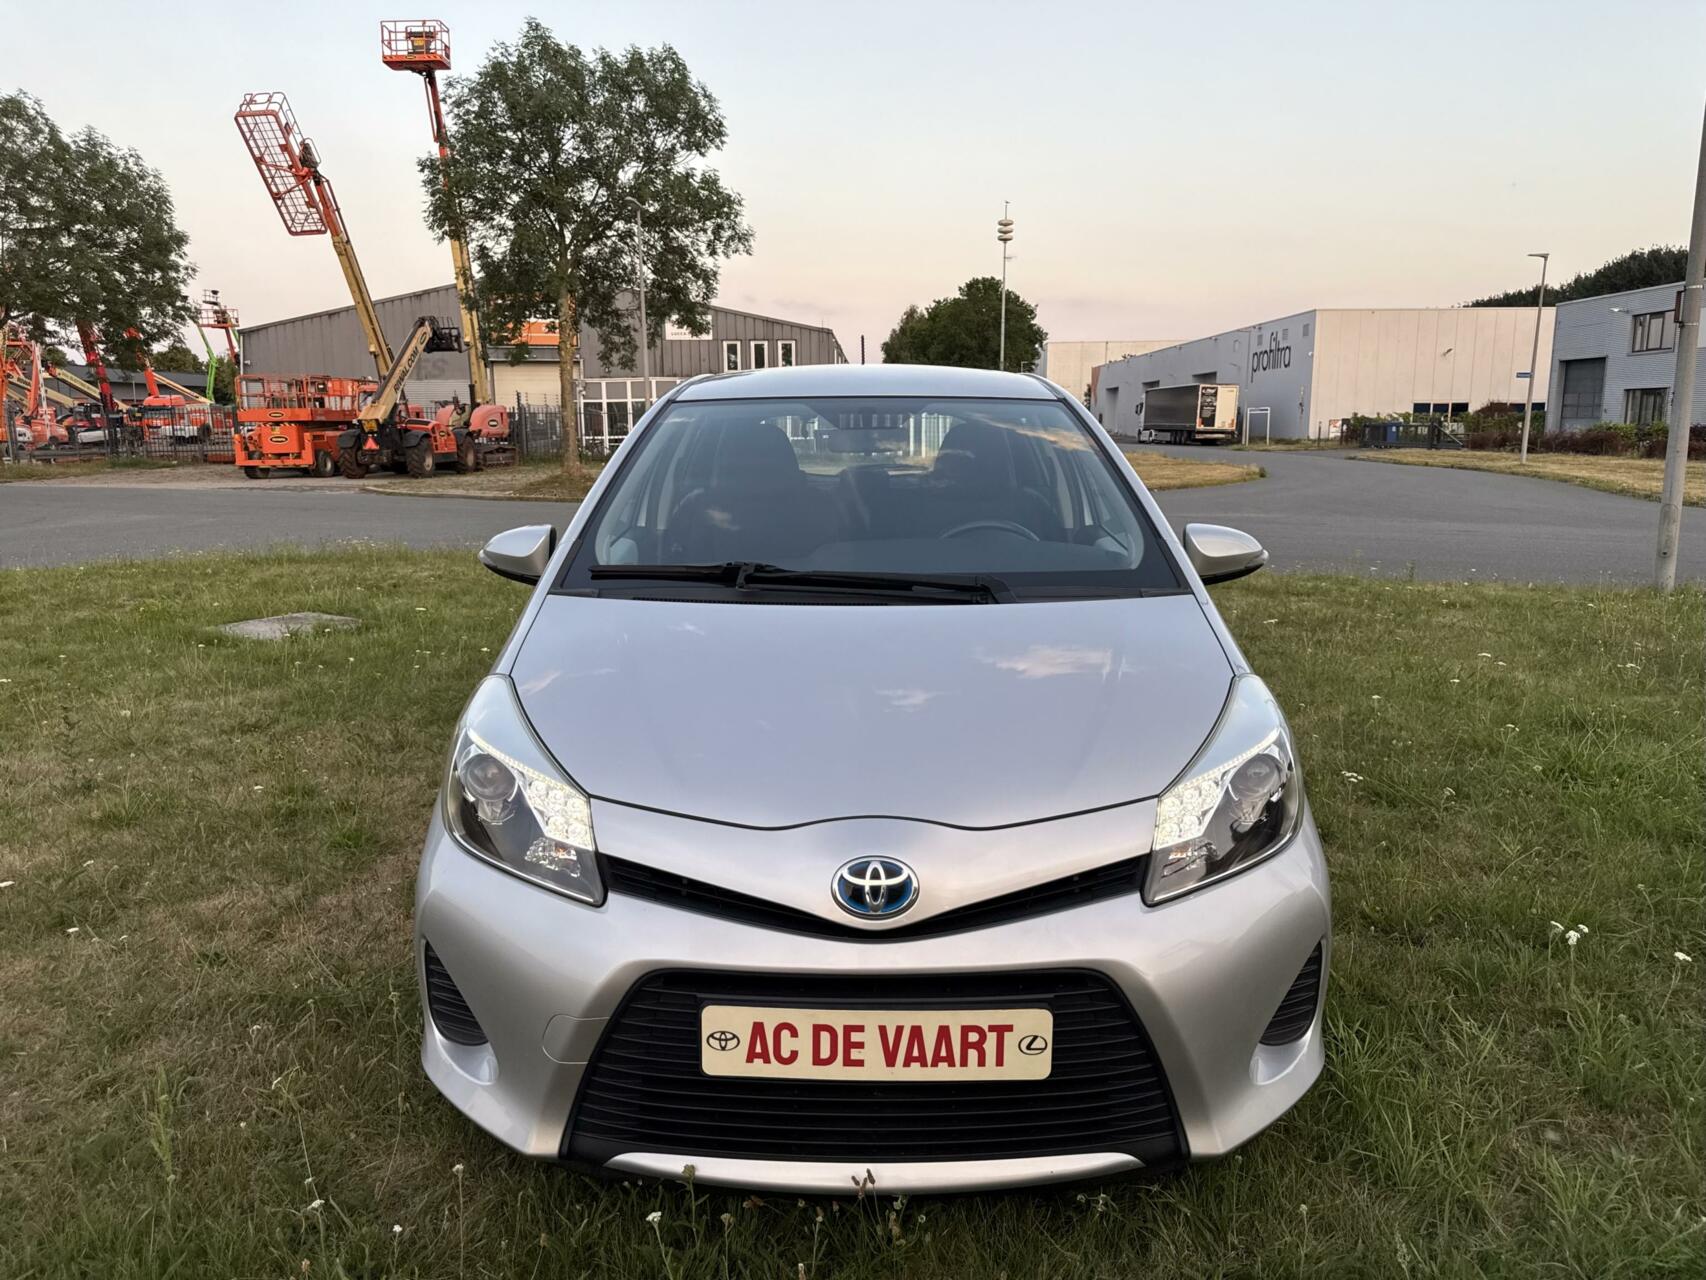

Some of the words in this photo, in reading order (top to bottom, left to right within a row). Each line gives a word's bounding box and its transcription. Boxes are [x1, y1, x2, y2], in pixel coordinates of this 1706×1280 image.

[1250, 331, 1291, 383] profiltra
[746, 1021, 799, 1065] AC
[812, 1023, 865, 1067] DE
[878, 1024, 1014, 1068] VAART
